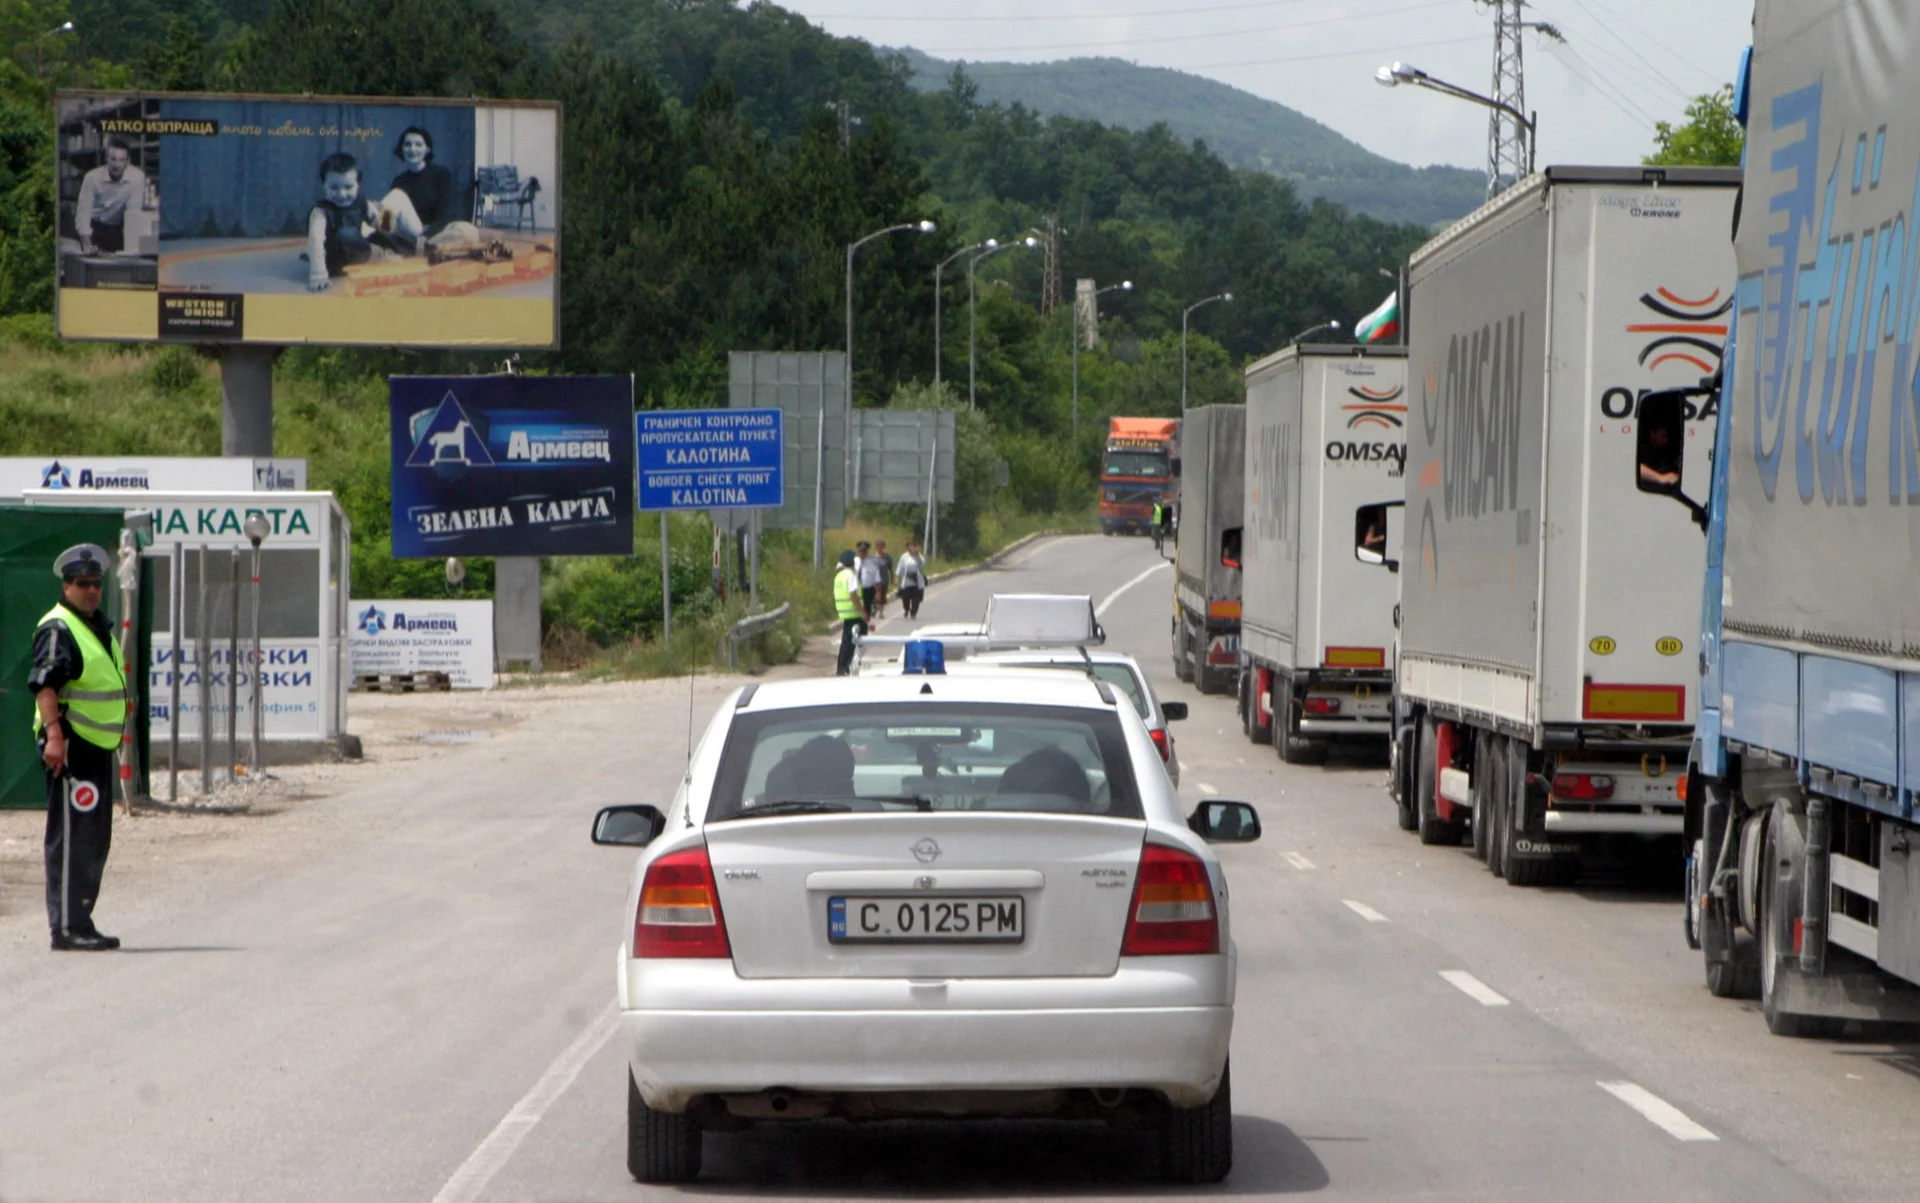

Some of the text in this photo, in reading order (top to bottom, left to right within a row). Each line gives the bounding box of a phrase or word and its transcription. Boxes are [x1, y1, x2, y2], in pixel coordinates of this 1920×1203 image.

[101, 120, 143, 132] ТАТКО
[147, 121, 214, 134] ИЗПРАЩА
[165, 299, 224, 309] WESTERN
[184, 308, 224, 317] UNION
[644, 415, 773, 430] ГРАНИЧЕН КОНТРОЛНО
[1444, 310, 1525, 522] OMSAN
[641, 429, 777, 444] ПРОПУСКАТЕЛЕН ПУНКТ
[507, 430, 611, 463] Армеец
[666, 447, 751, 464] КАЛОТИНА
[78, 469, 149, 490] Армеец
[648, 472, 771, 488] BORDER CHECK POINT
[672, 488, 747, 505] KALOTINA
[151, 508, 189, 535] НА
[417, 496, 610, 534] ЗЕЛЕНА КАРТА
[393, 613, 457, 632] Армеец
[412, 638, 472, 647] ЗАСТРАХОВКИ
[1596, 640, 1610, 651] 70
[1661, 640, 1677, 651] 80
[150, 649, 308, 667] ИЦИНСКИ
[150, 671, 311, 687] ТРАХОВКИ
[308, 702, 317, 712] 5
